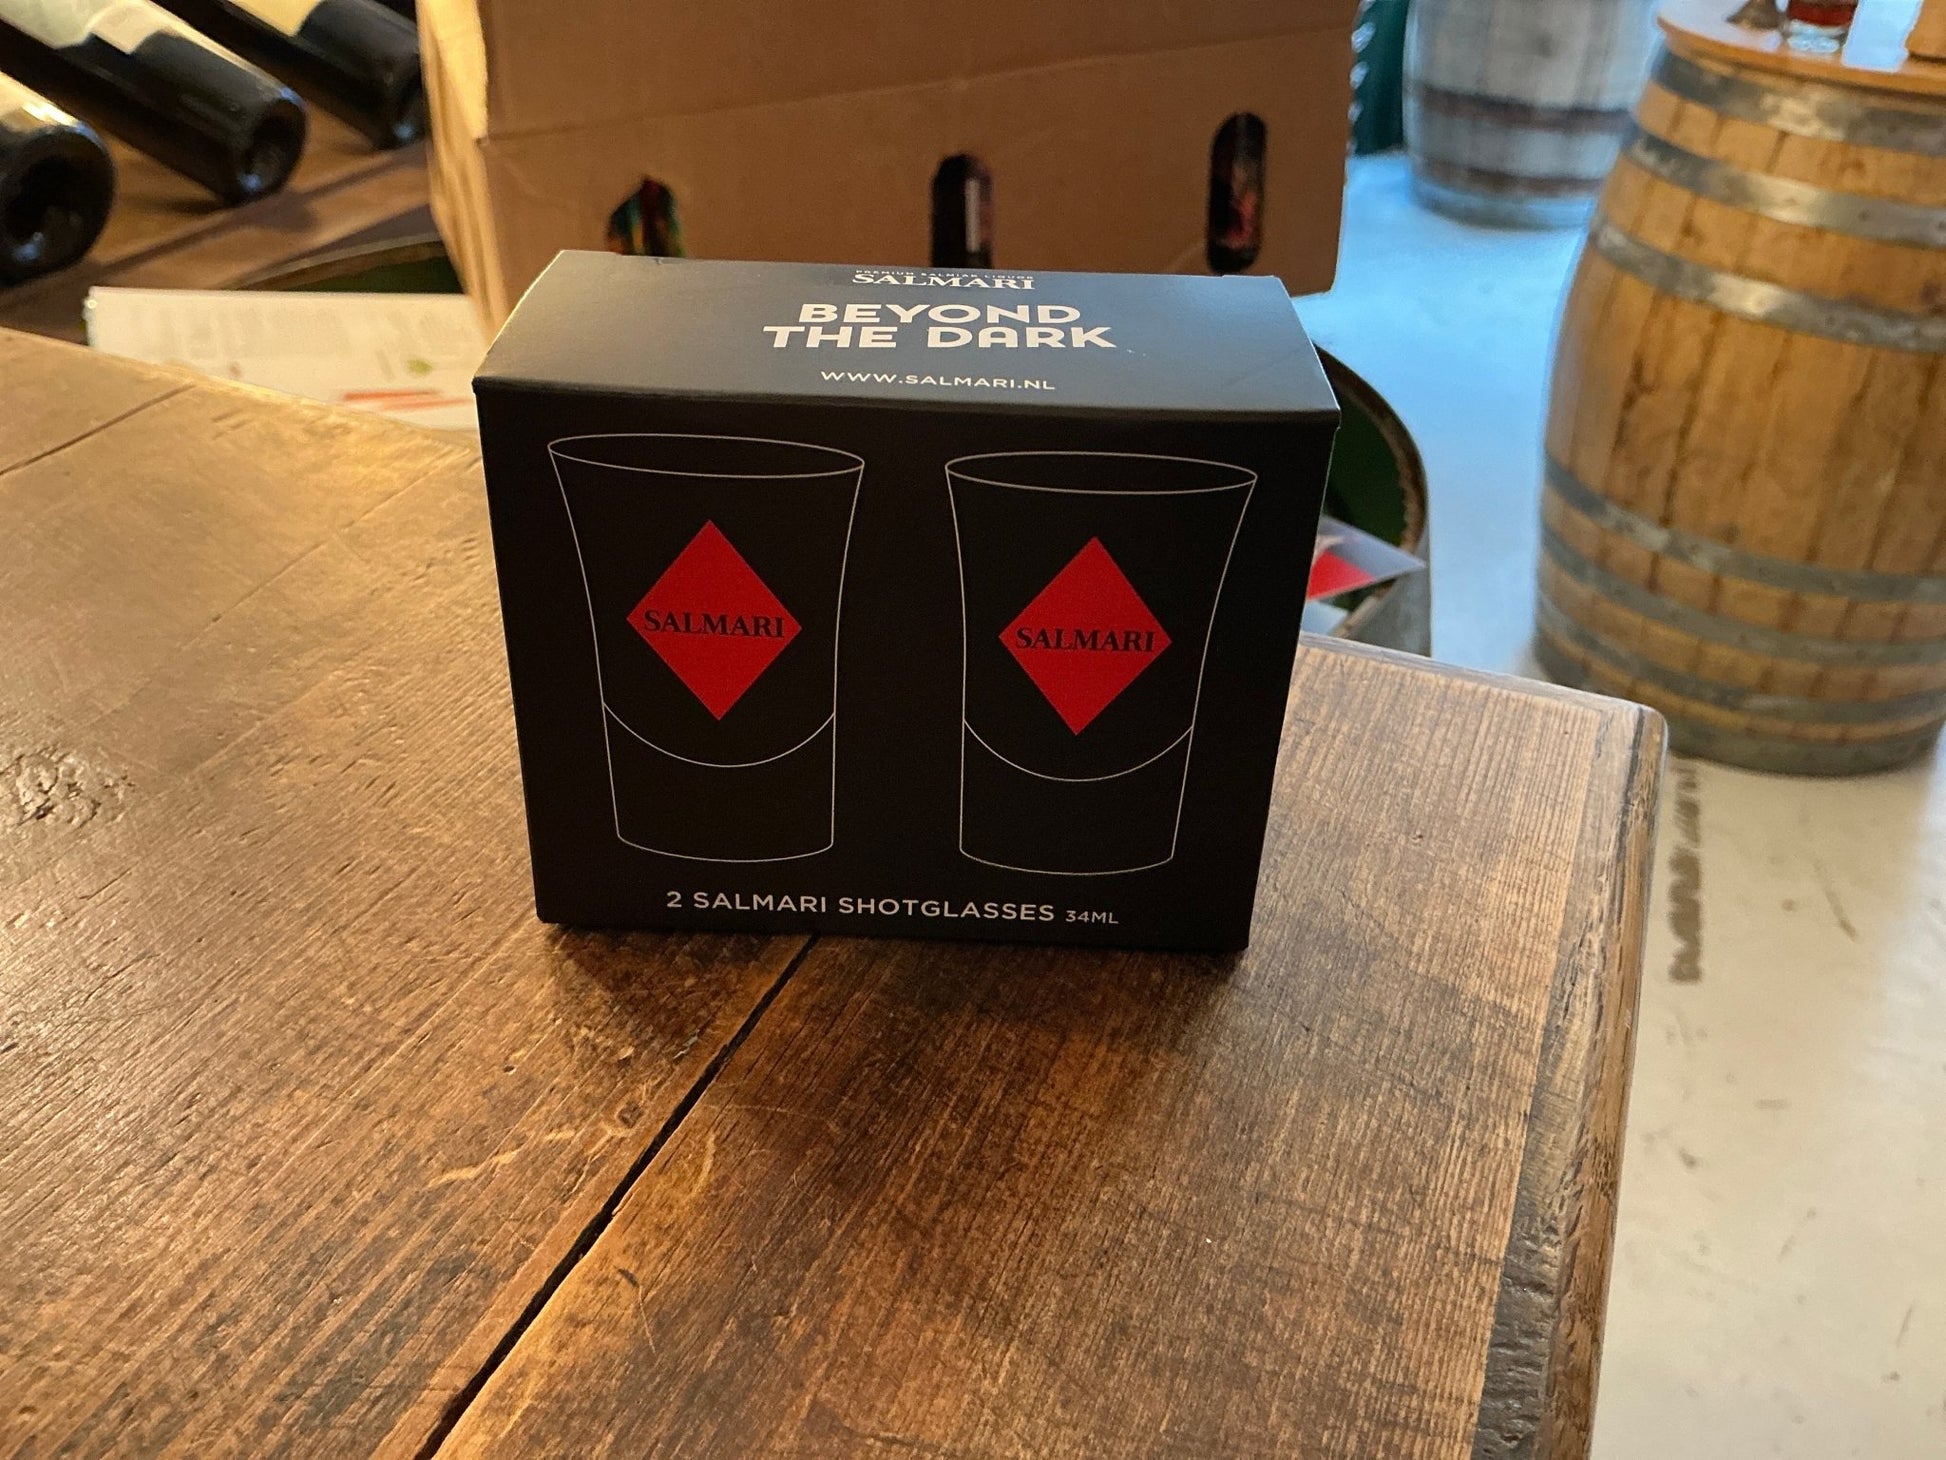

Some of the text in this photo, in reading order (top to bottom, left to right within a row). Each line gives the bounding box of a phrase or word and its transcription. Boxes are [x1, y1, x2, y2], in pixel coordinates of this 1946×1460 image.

[852, 273, 1036, 290] SALMARI
[798, 303, 1082, 324] BEYOND
[763, 326, 1118, 349] THE DARK
[820, 371, 1056, 390] WWW.SALMARI.NL
[643, 609, 786, 638] SALMARI
[1015, 627, 1156, 653] SALMARI
[666, 891, 1119, 925] 2 SALMARI SHOTGLASSES 34ML
